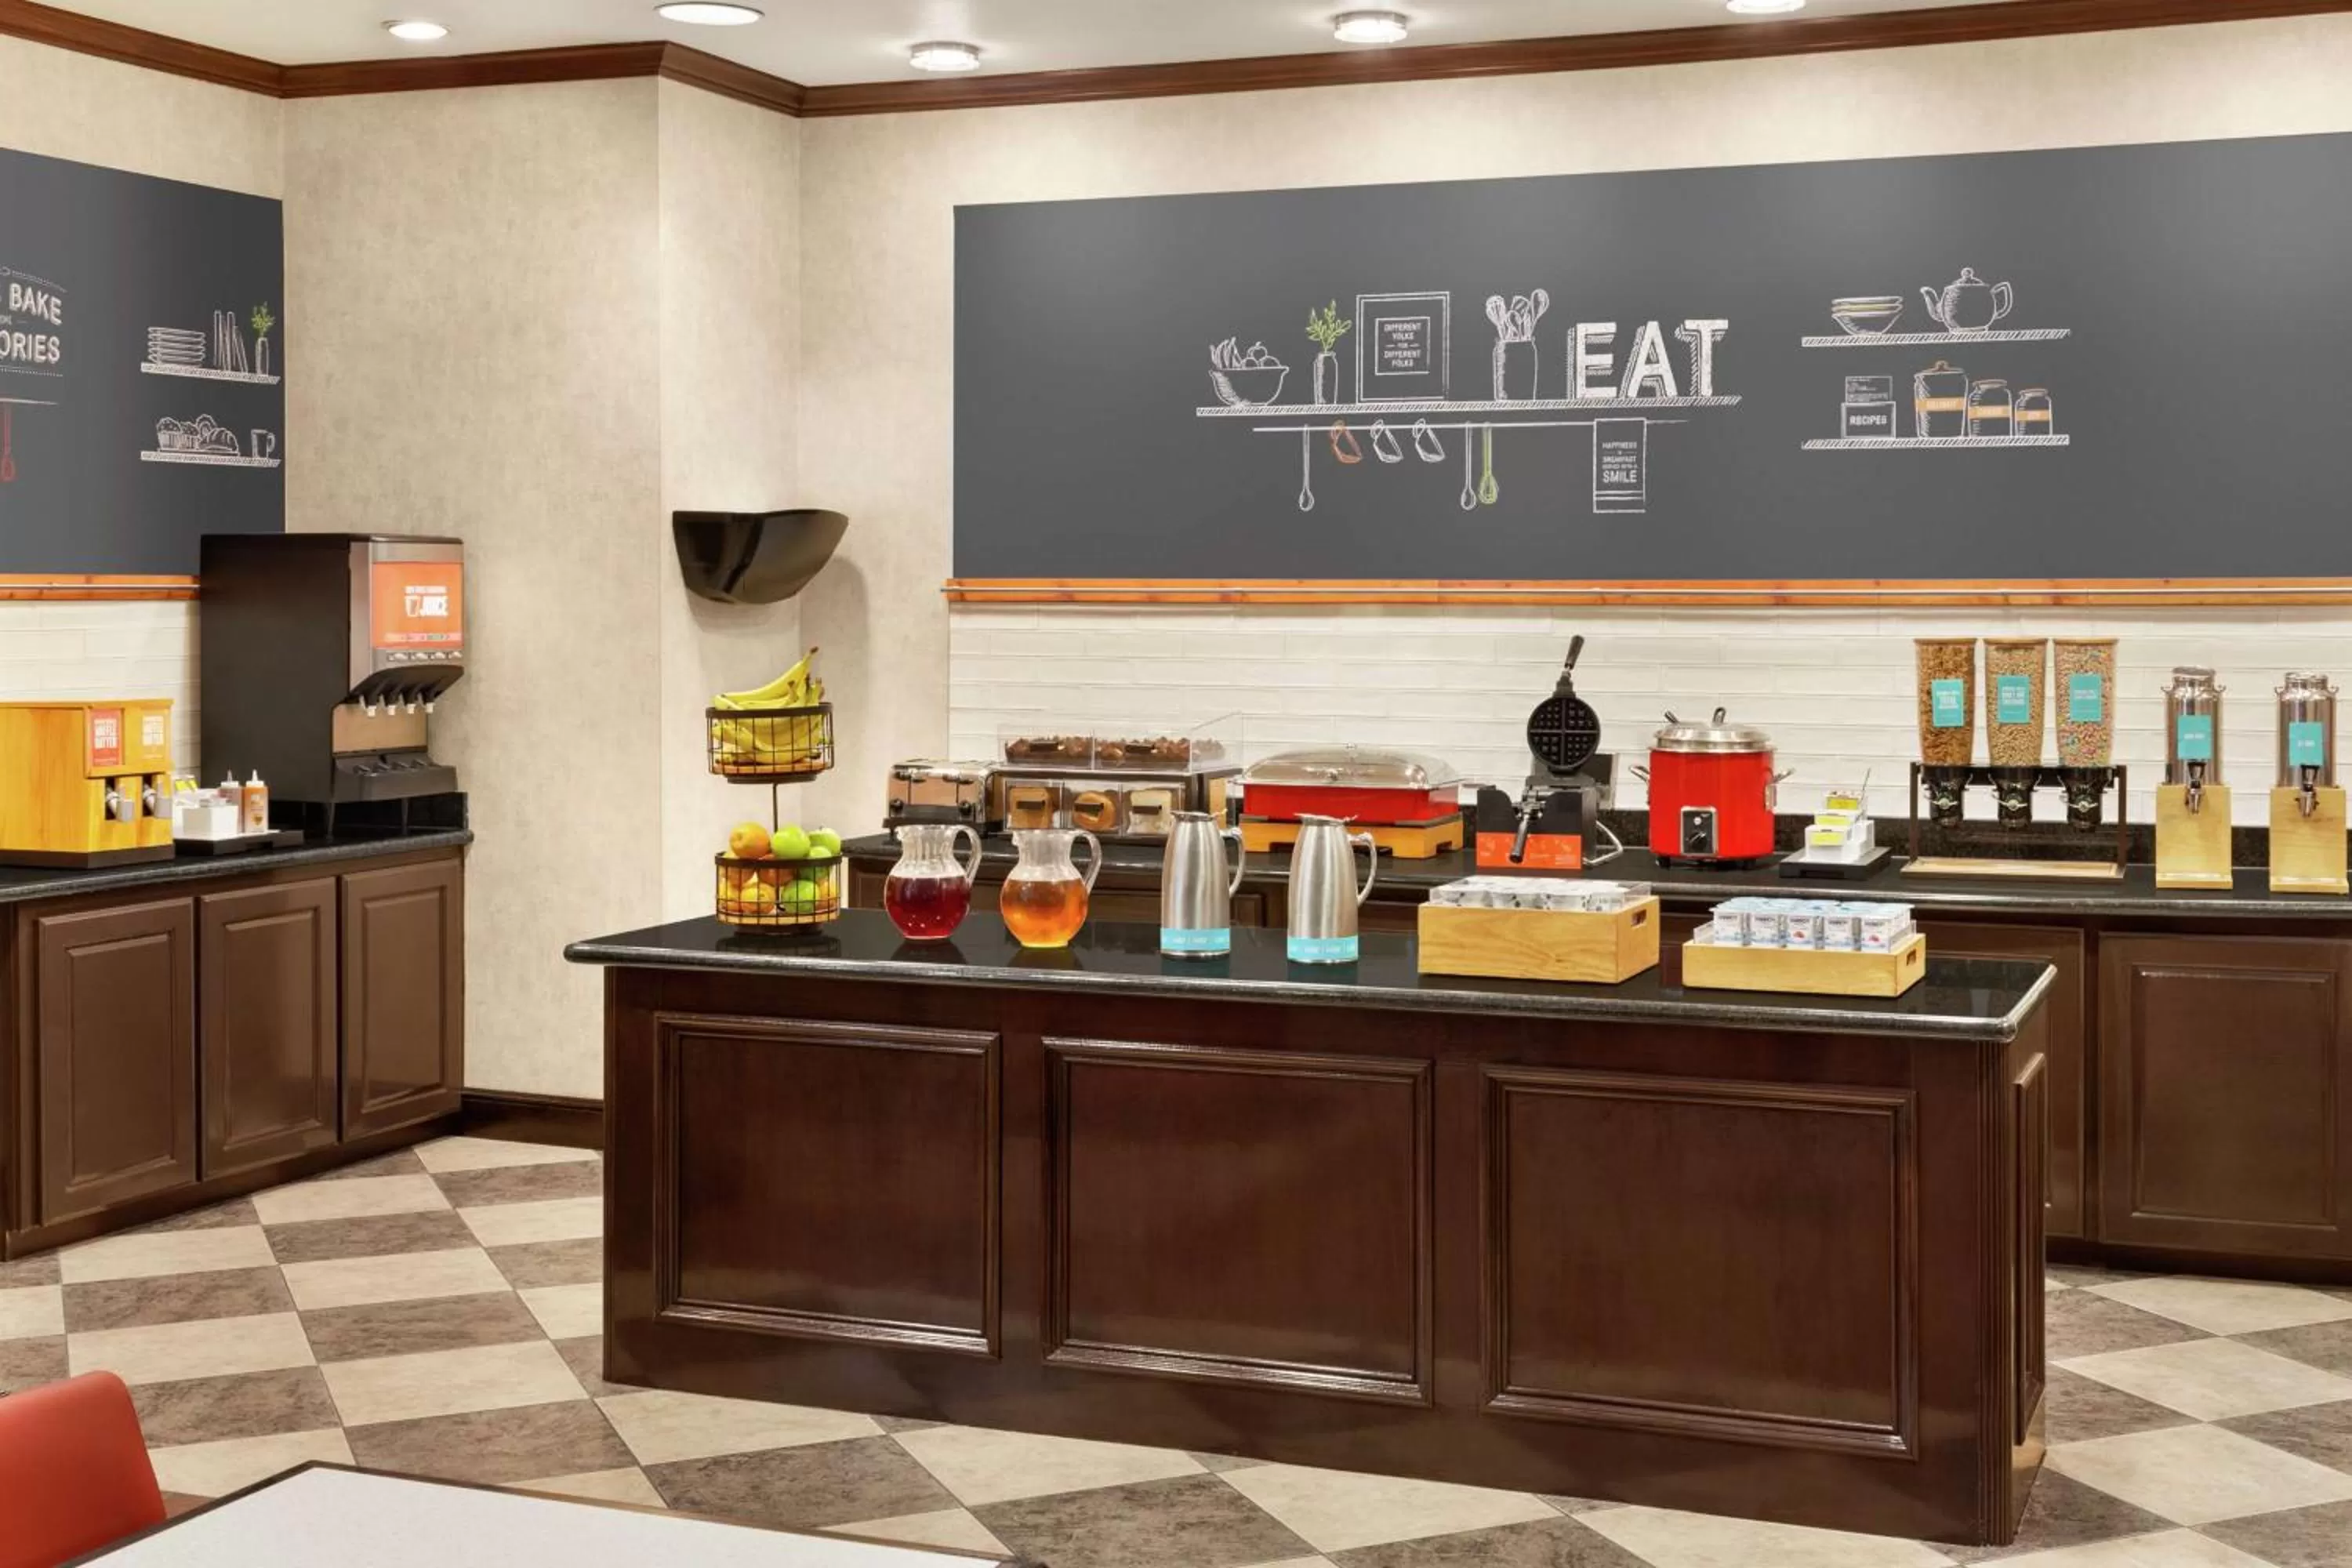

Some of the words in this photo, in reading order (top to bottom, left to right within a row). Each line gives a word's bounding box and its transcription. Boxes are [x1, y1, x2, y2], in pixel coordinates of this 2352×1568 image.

[9, 282, 63, 325] BAKE
[1384, 322, 1421, 332] DIFFERENT
[1384, 350, 1421, 359] DIFFERENT
[1568, 319, 1729, 397] EAT
[1849, 415, 1888, 426] RECIPES
[1602, 470, 1637, 483] SMILE
